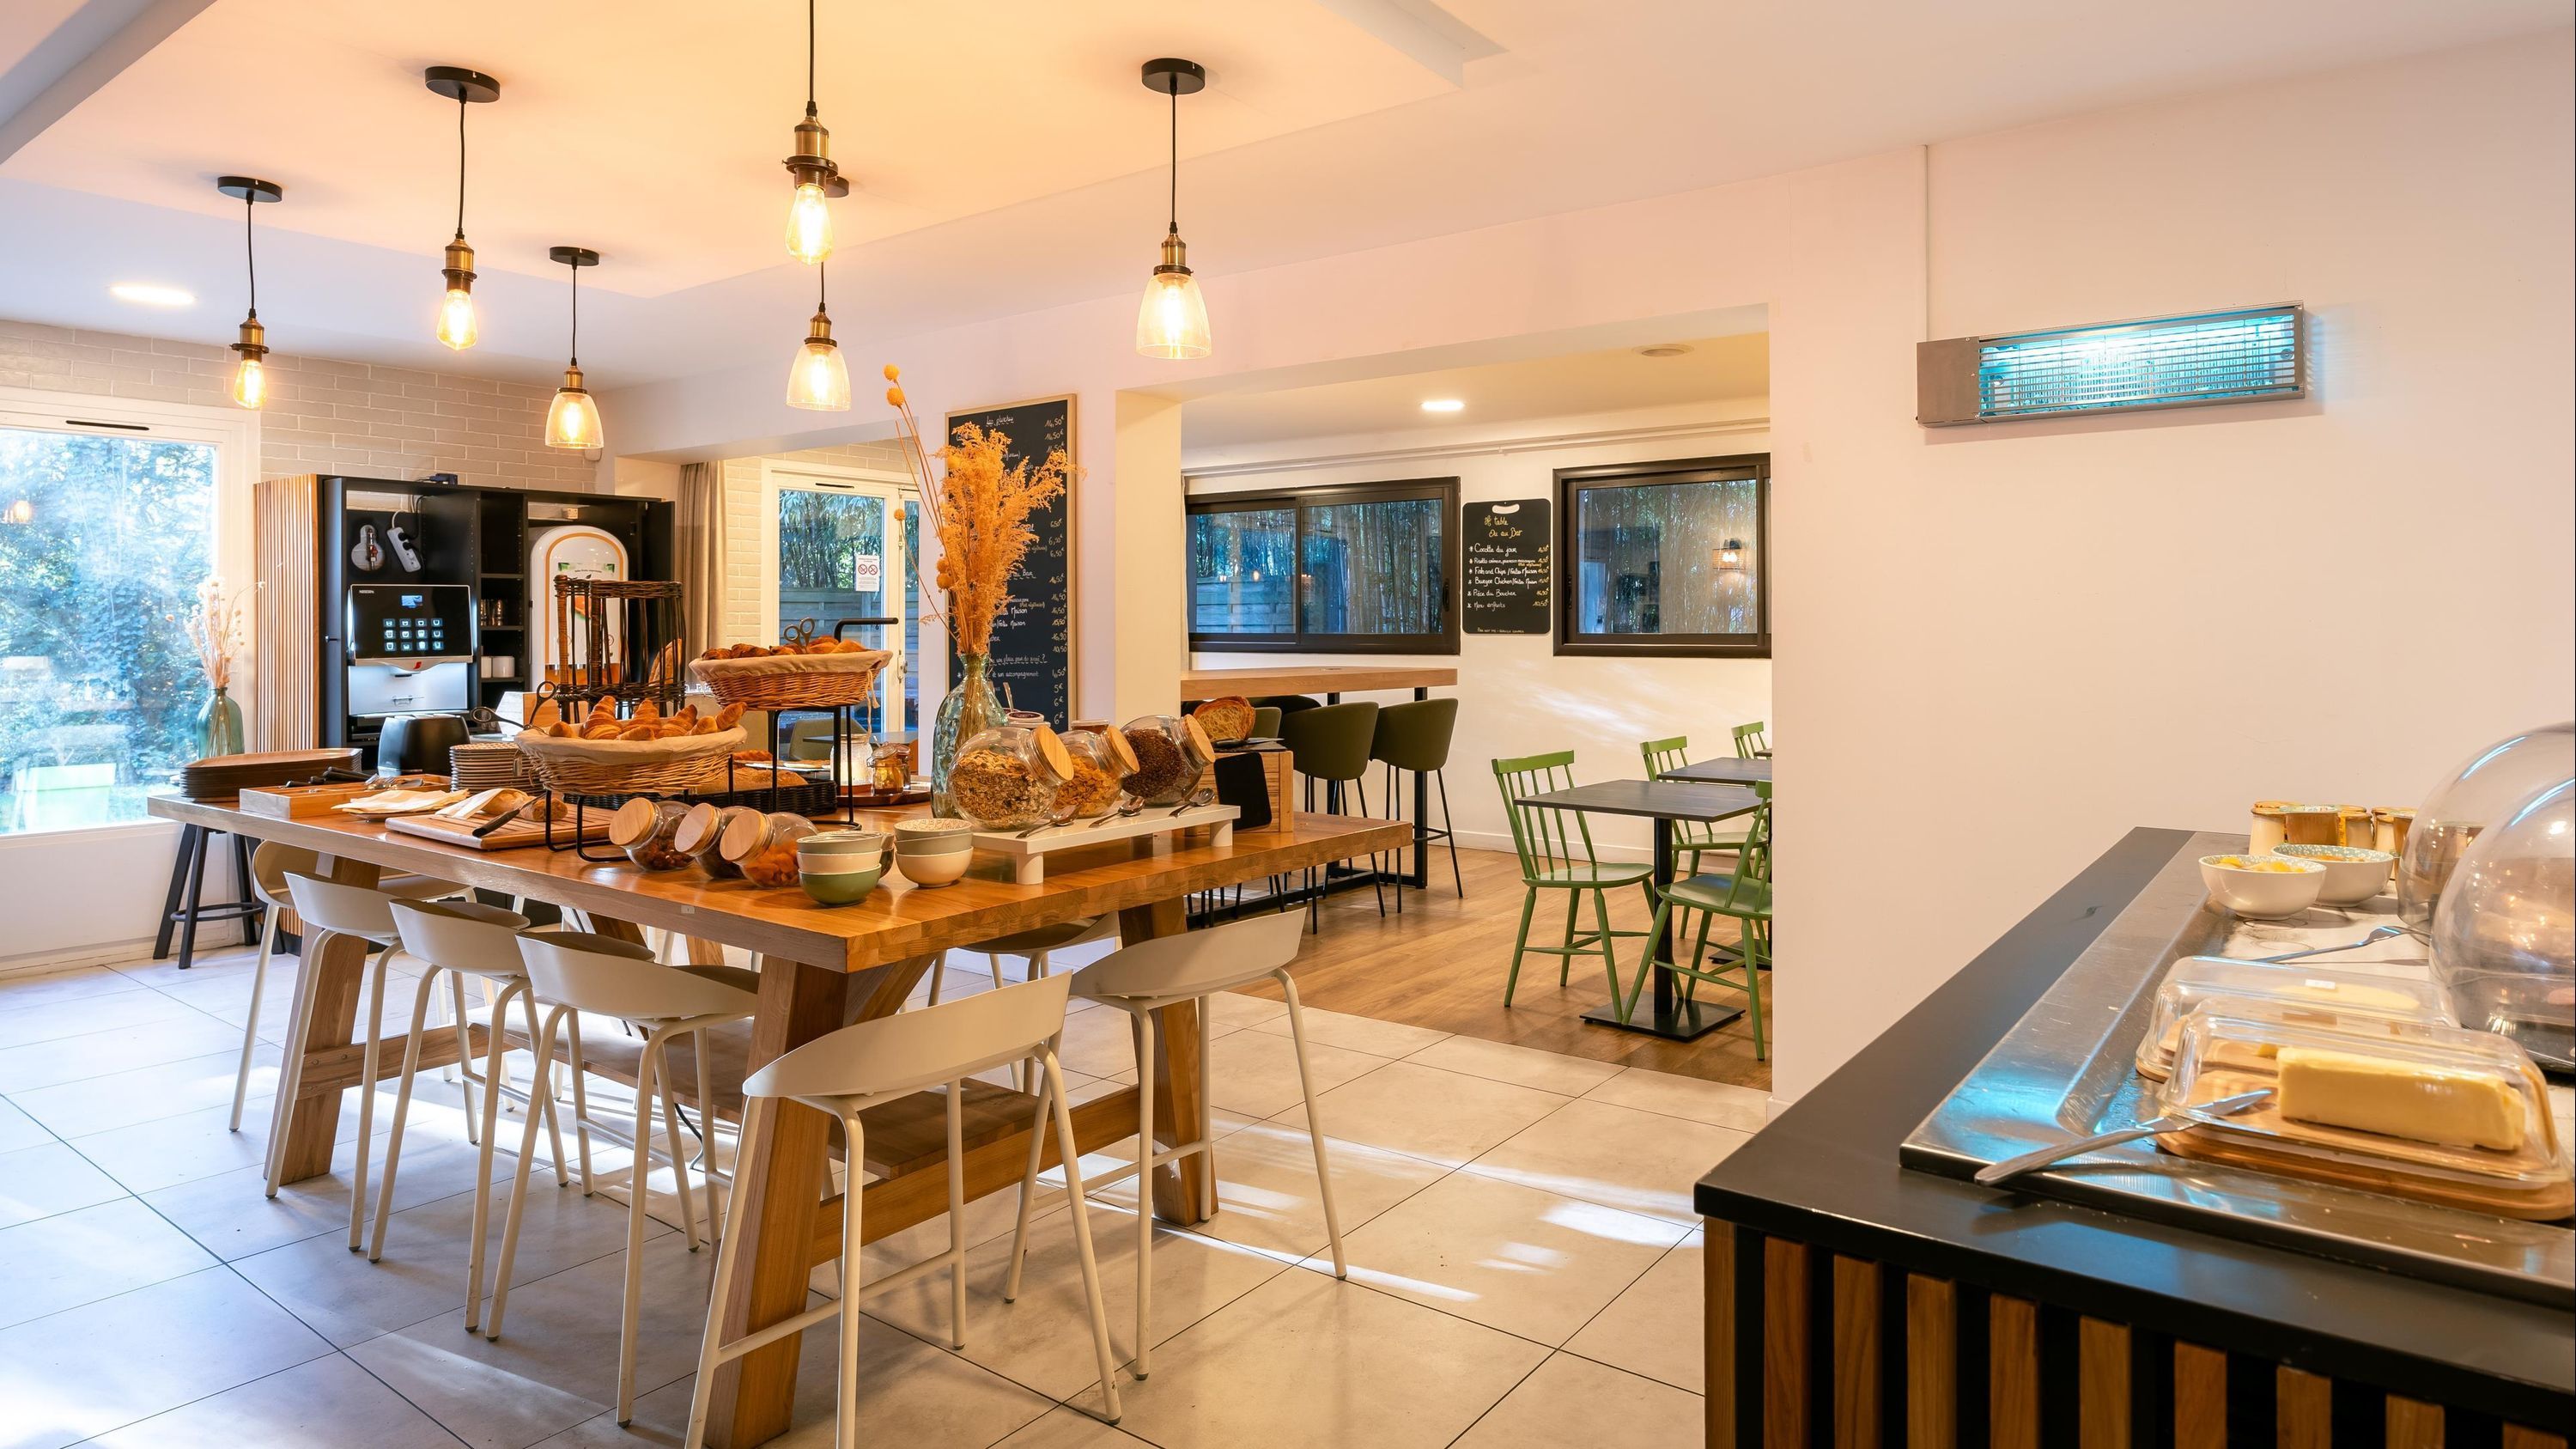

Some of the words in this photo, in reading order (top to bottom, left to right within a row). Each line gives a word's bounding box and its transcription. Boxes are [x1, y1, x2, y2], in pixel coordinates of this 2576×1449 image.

[1494, 516, 1509, 526] table
[1473, 542, 1494, 553] Cocotte
[1504, 547, 1517, 557] jour
[1494, 567, 1506, 575] Chips
